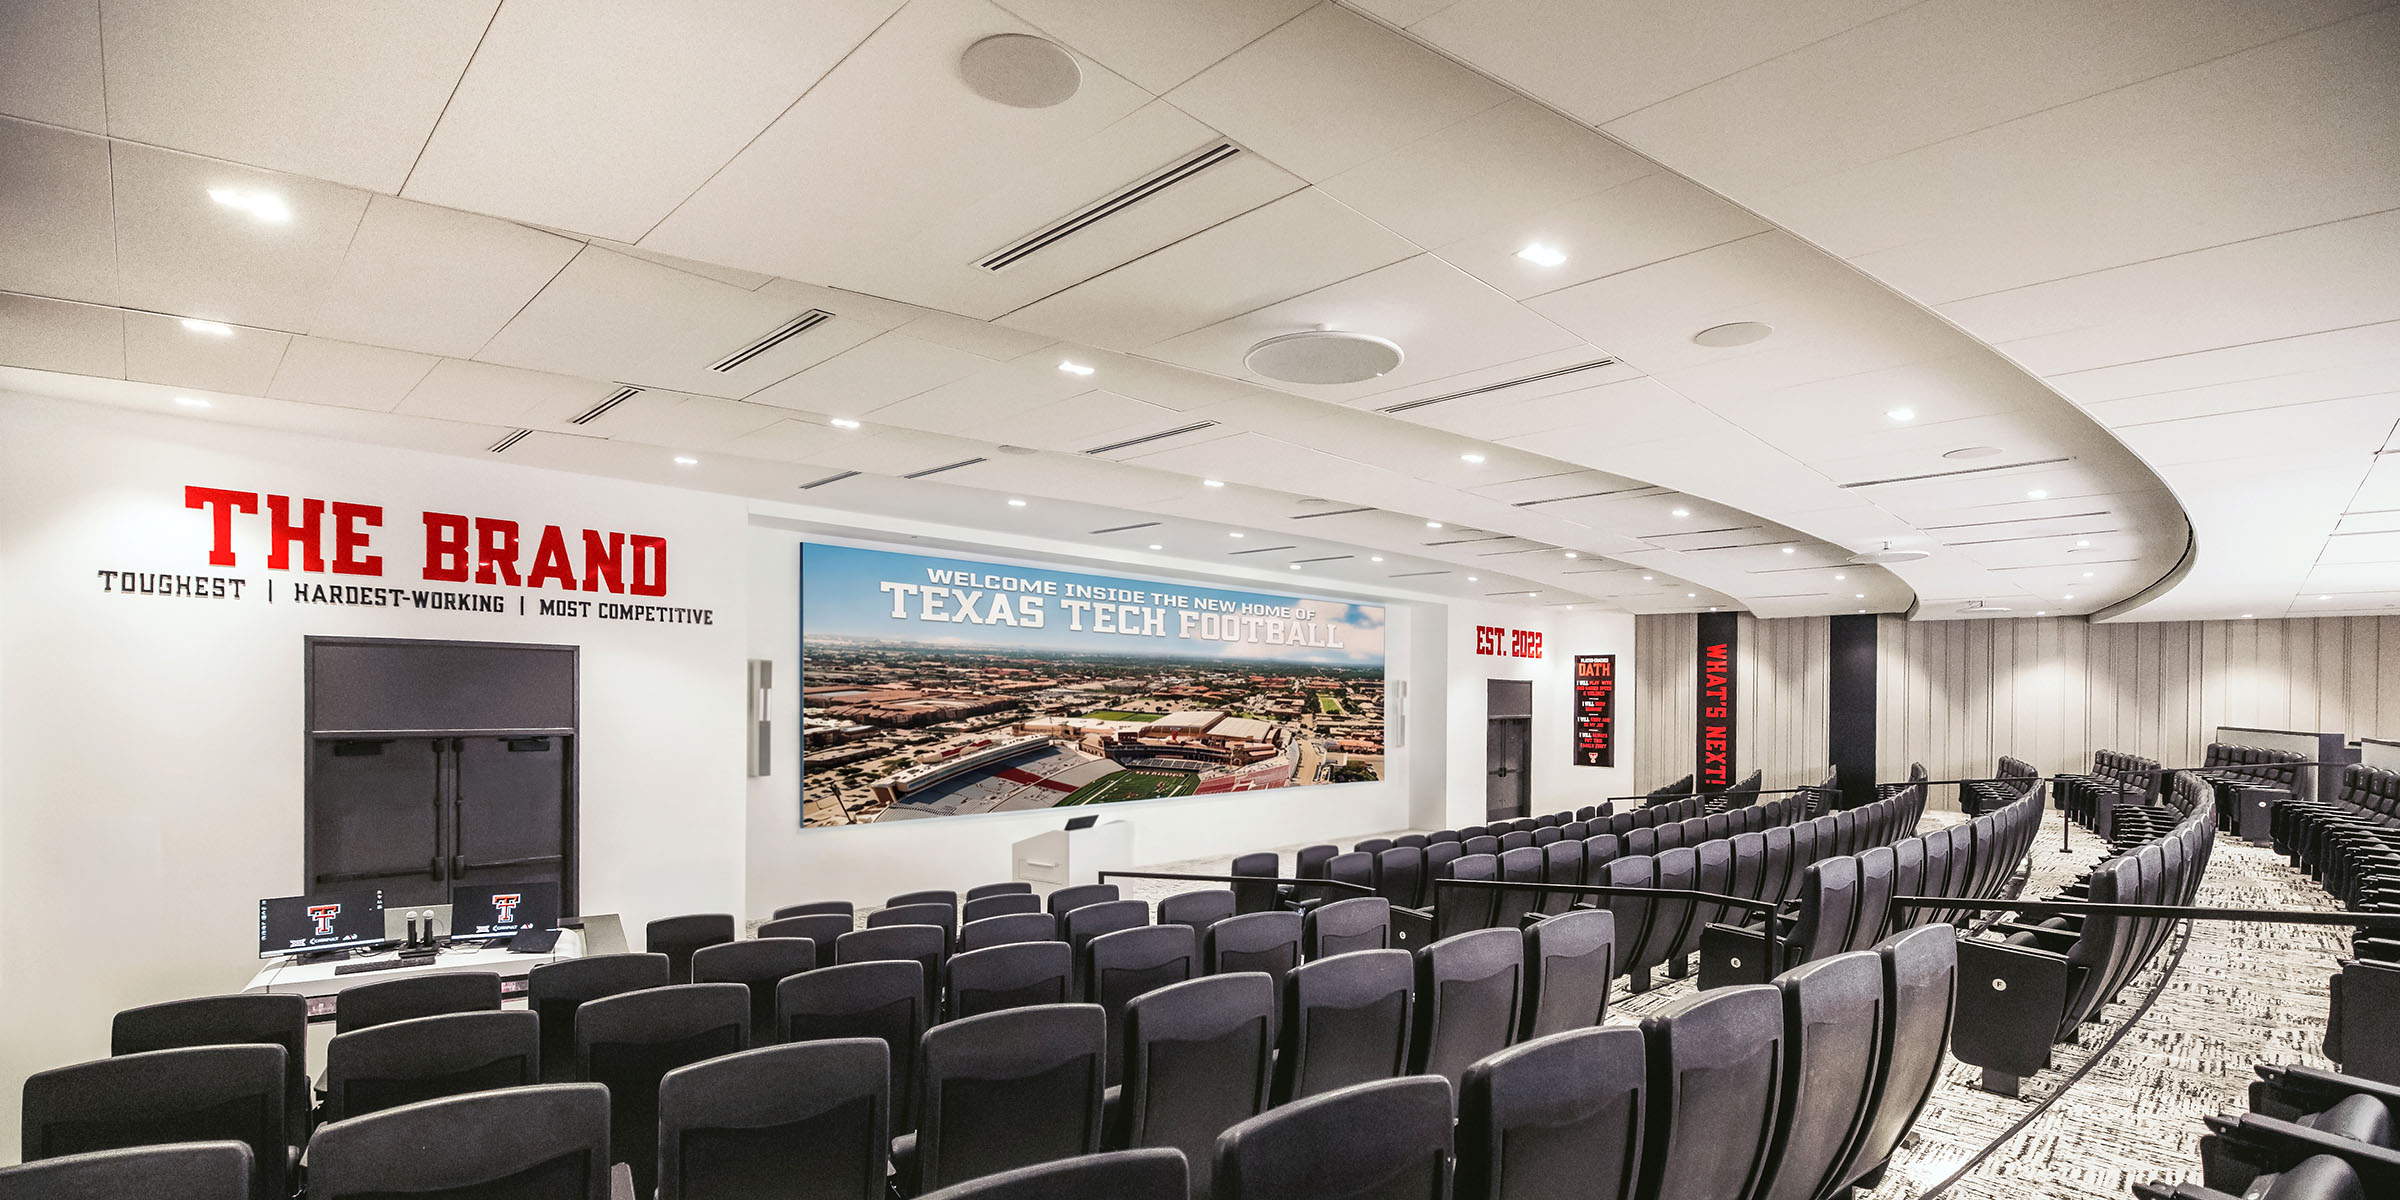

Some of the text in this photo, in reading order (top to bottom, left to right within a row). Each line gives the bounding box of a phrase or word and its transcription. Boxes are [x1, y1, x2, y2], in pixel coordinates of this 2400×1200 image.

[185, 485, 666, 598] THE BRAND
[98, 570, 246, 599] TOUGHEST
[294, 582, 504, 613] HARDEST-WORKING
[539, 599, 592, 618] MOST
[598, 602, 713, 625] COMPETITIVE
[880, 581, 1345, 649] TEXAS TECH FOOTBALL
[926, 567, 1316, 621] WELCOME INSIDE THE NEW HOME OF
[1476, 625, 1543, 659] EST. 2022
[1578, 662, 1611, 677] OATH
[1705, 643, 1728, 785] WHAT'S NEXT!
